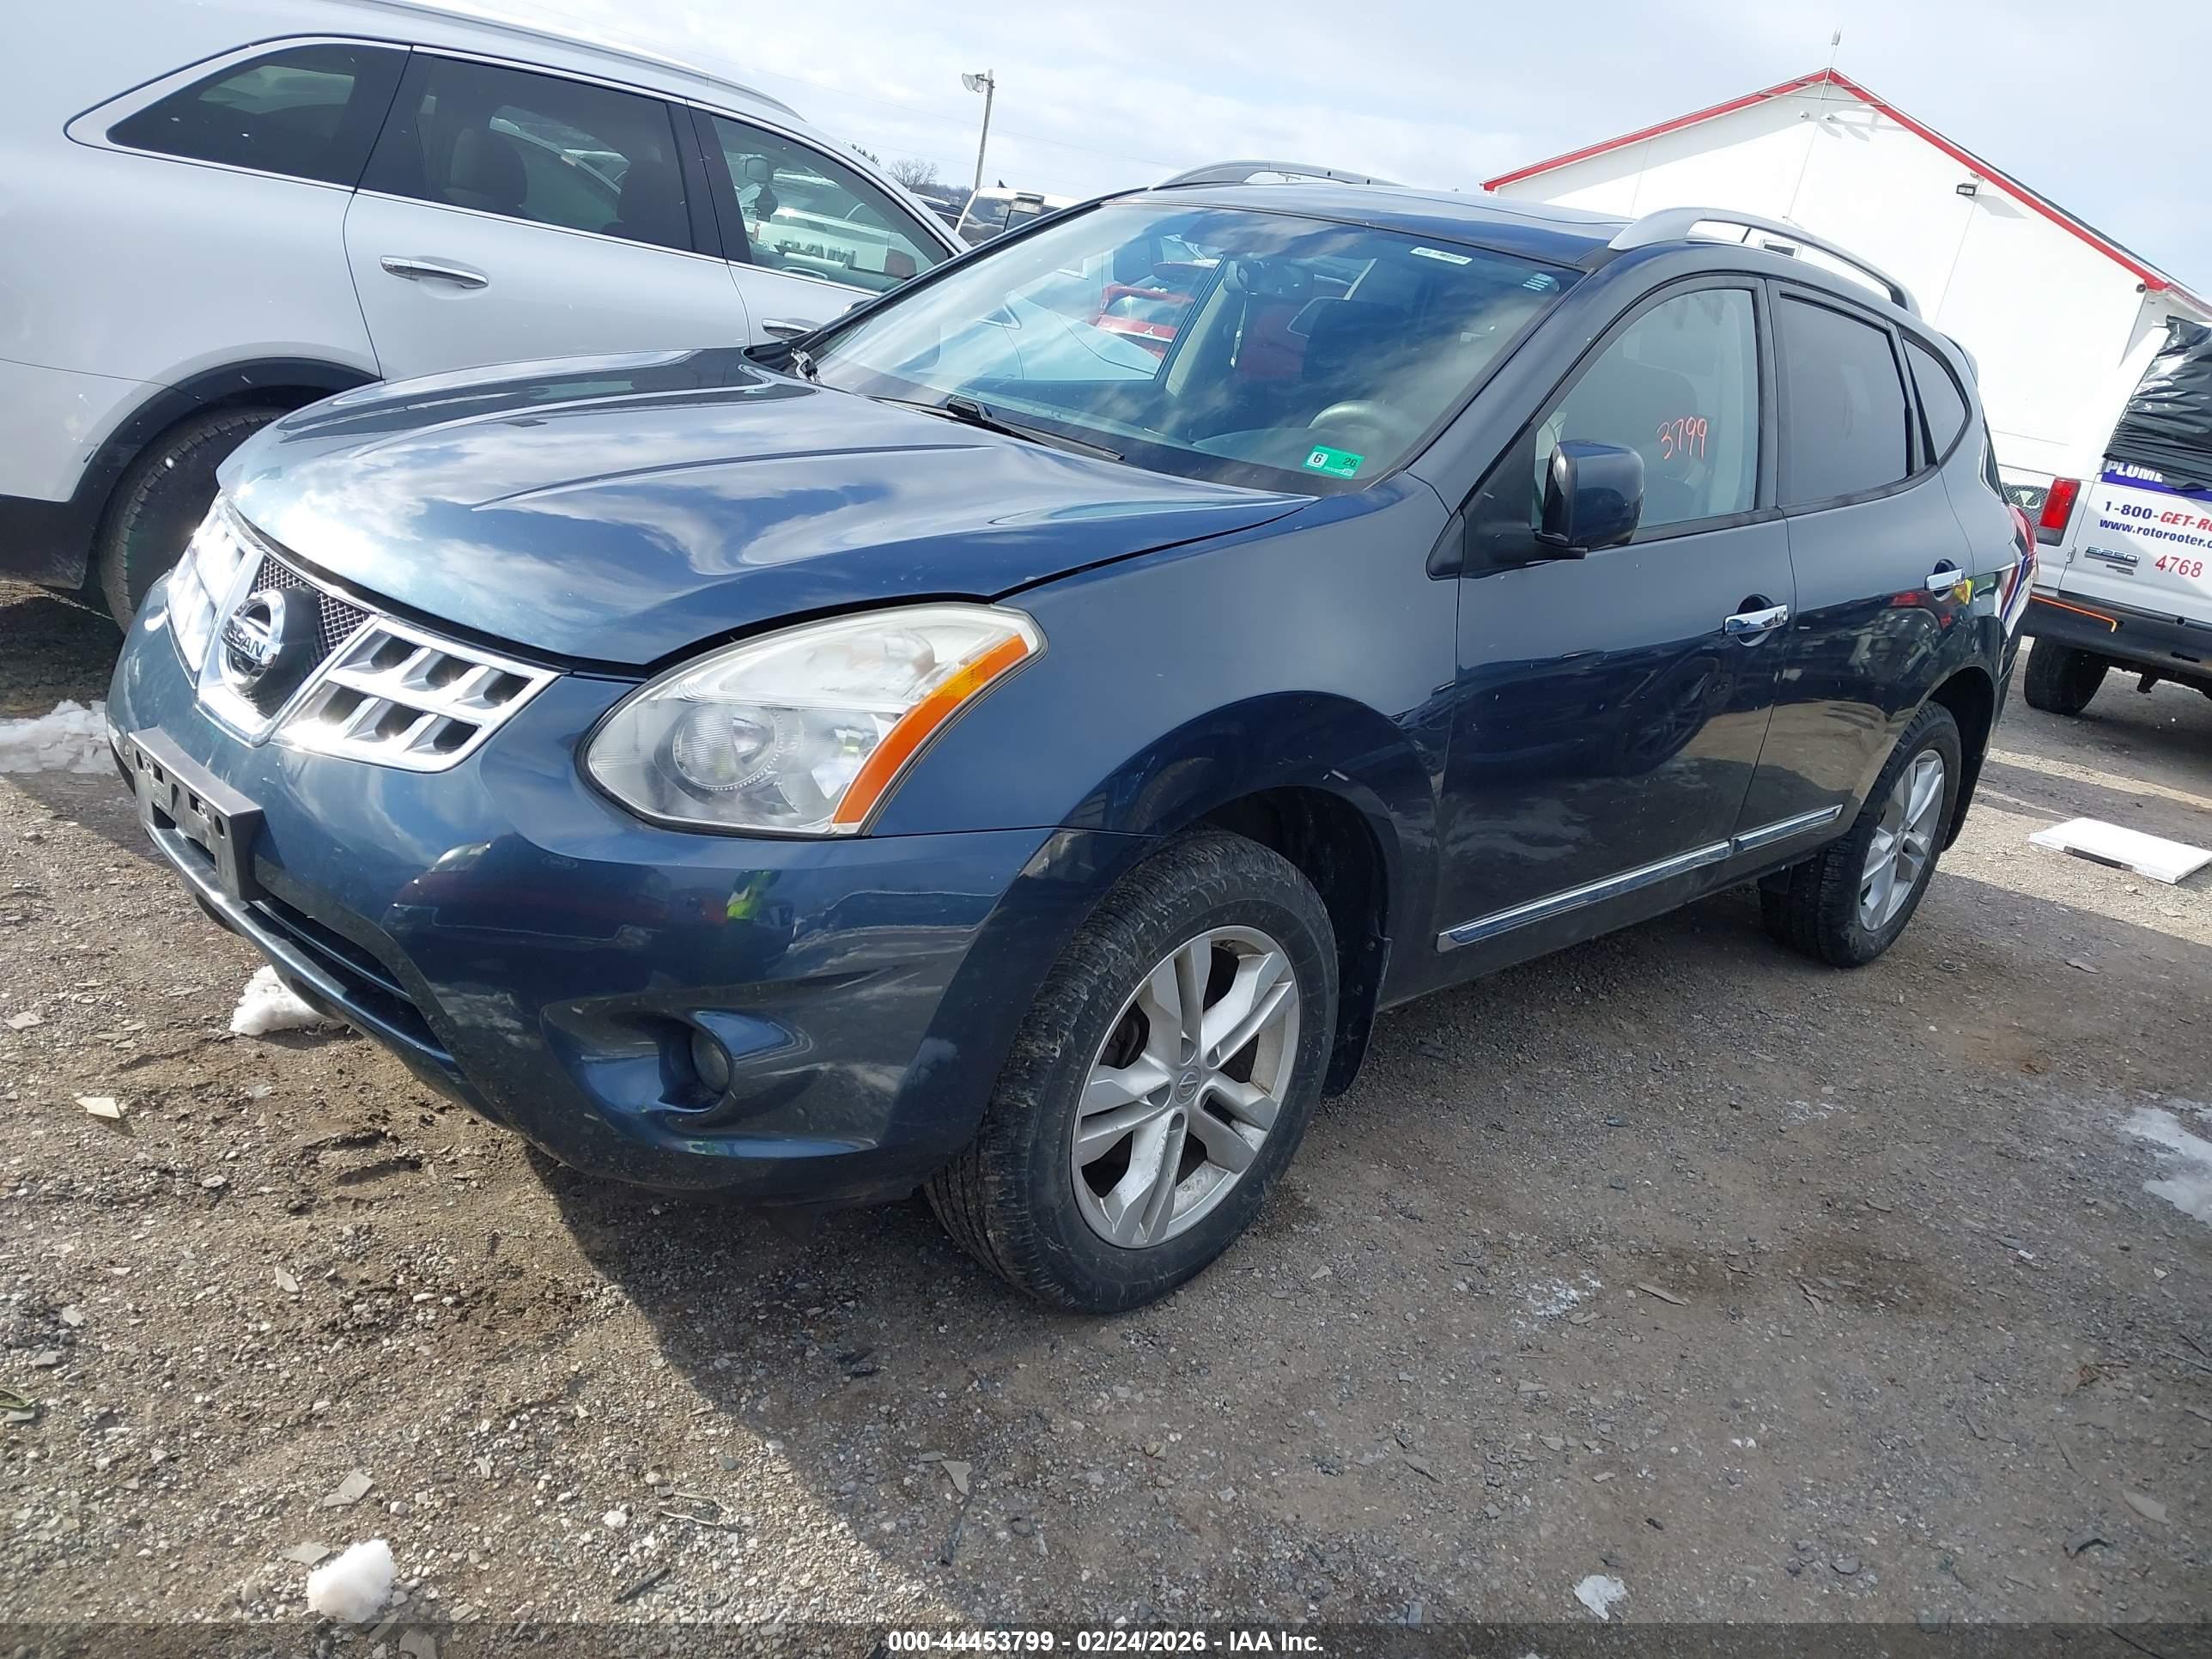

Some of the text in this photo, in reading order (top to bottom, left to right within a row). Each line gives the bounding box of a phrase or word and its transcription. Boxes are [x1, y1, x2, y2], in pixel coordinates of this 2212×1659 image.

[1656, 416, 1707, 459] 3799
[1313, 453, 1324, 464] 6
[2154, 555, 2203, 578] 4768
[222, 621, 266, 659] SSAN
